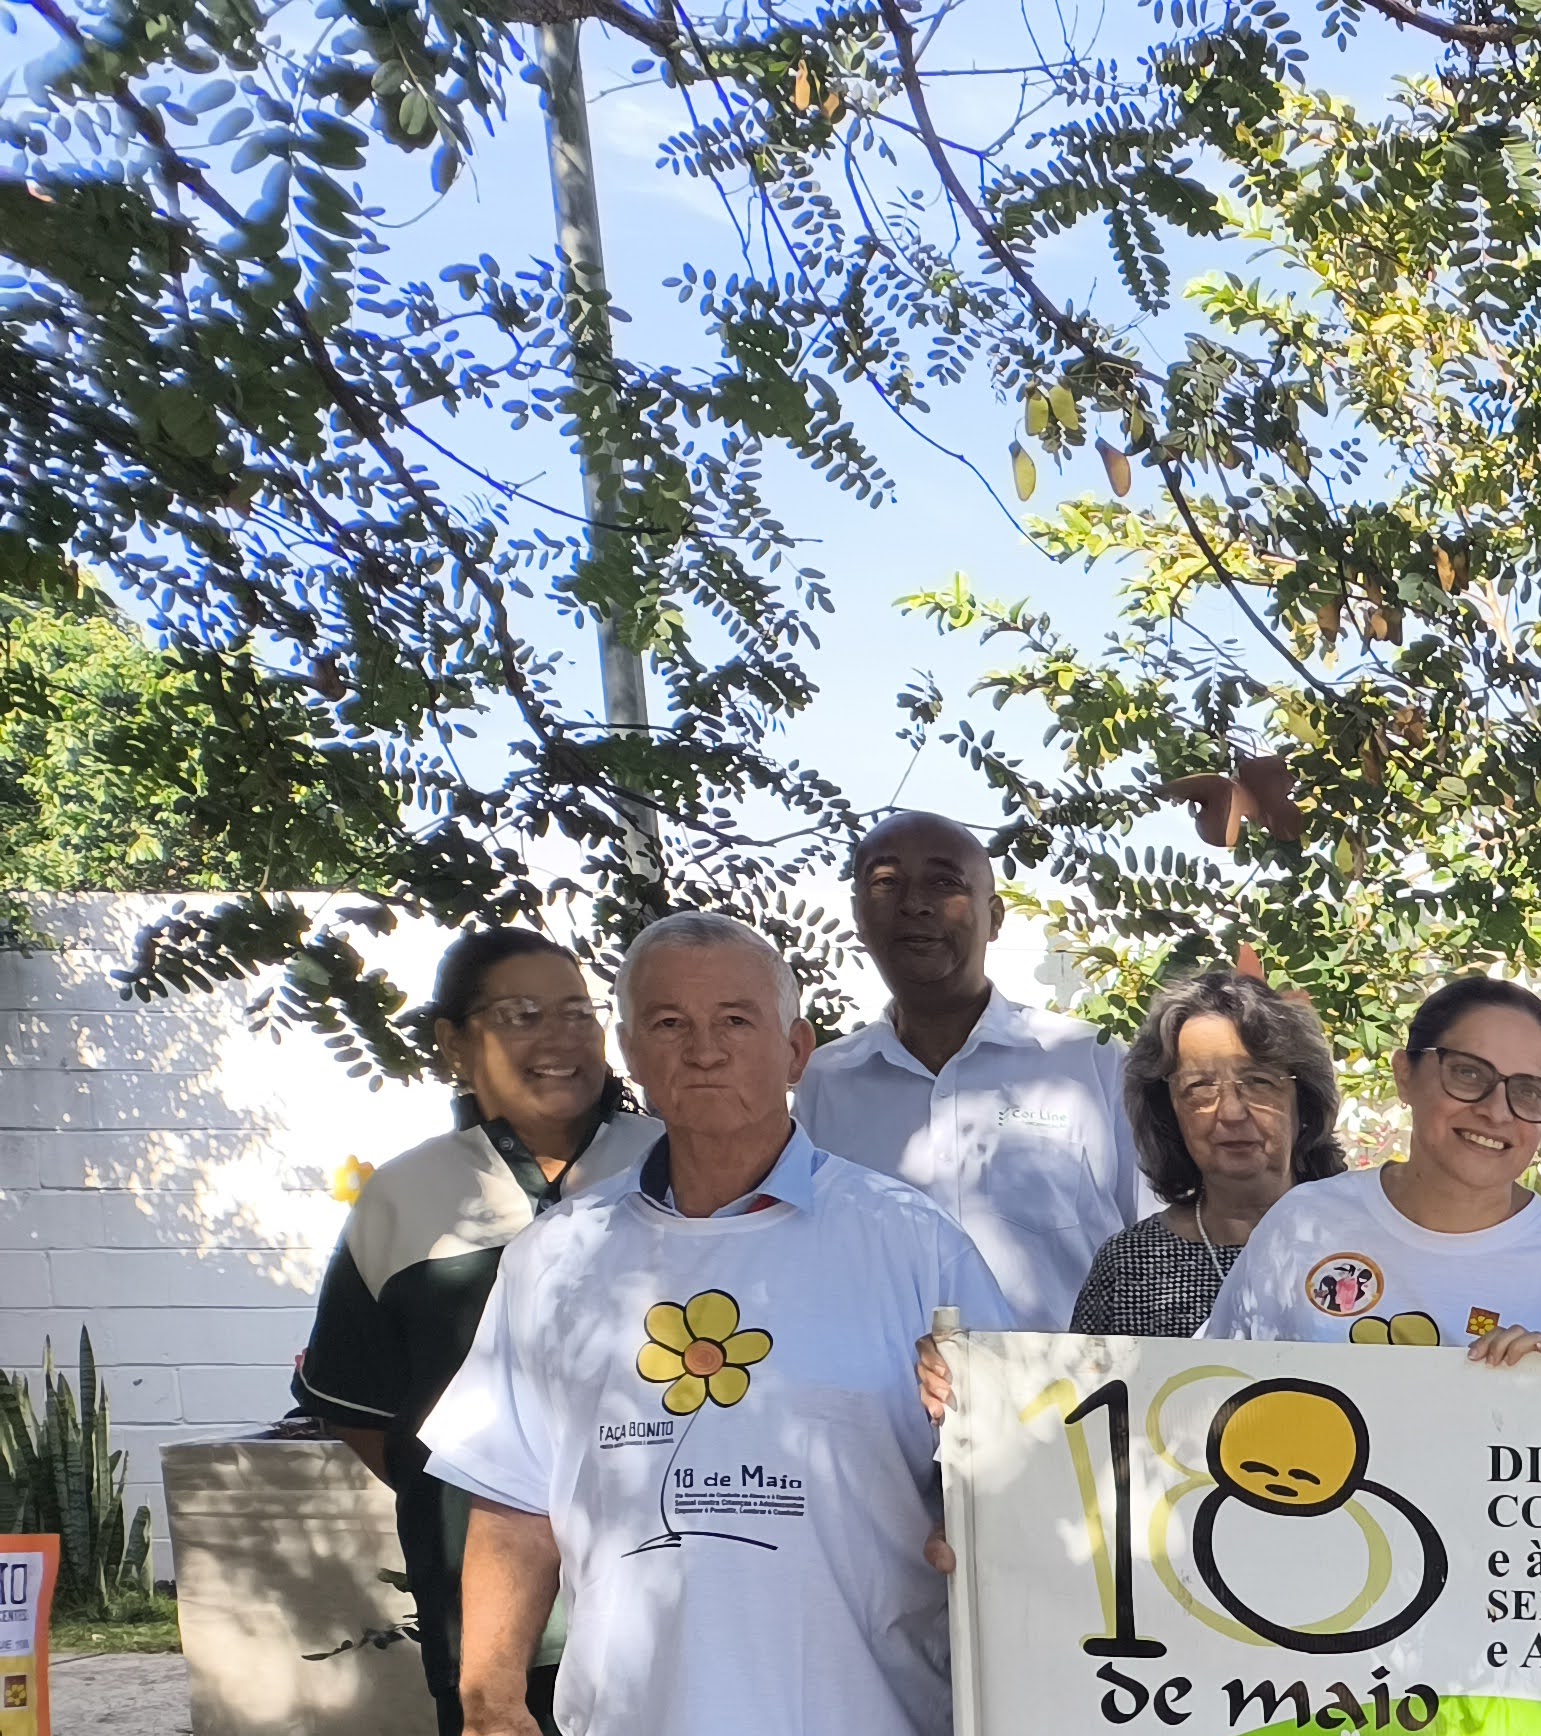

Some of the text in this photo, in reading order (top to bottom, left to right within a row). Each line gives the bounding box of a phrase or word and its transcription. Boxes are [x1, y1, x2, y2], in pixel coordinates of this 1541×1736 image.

[600, 1421, 674, 1441] FAÇA BONITO
[673, 1465, 802, 1489] 18 de Maio
[1488, 1551, 1510, 1579] e
[1487, 1642, 1508, 1668] e
[1096, 1661, 1440, 1732] de maio
